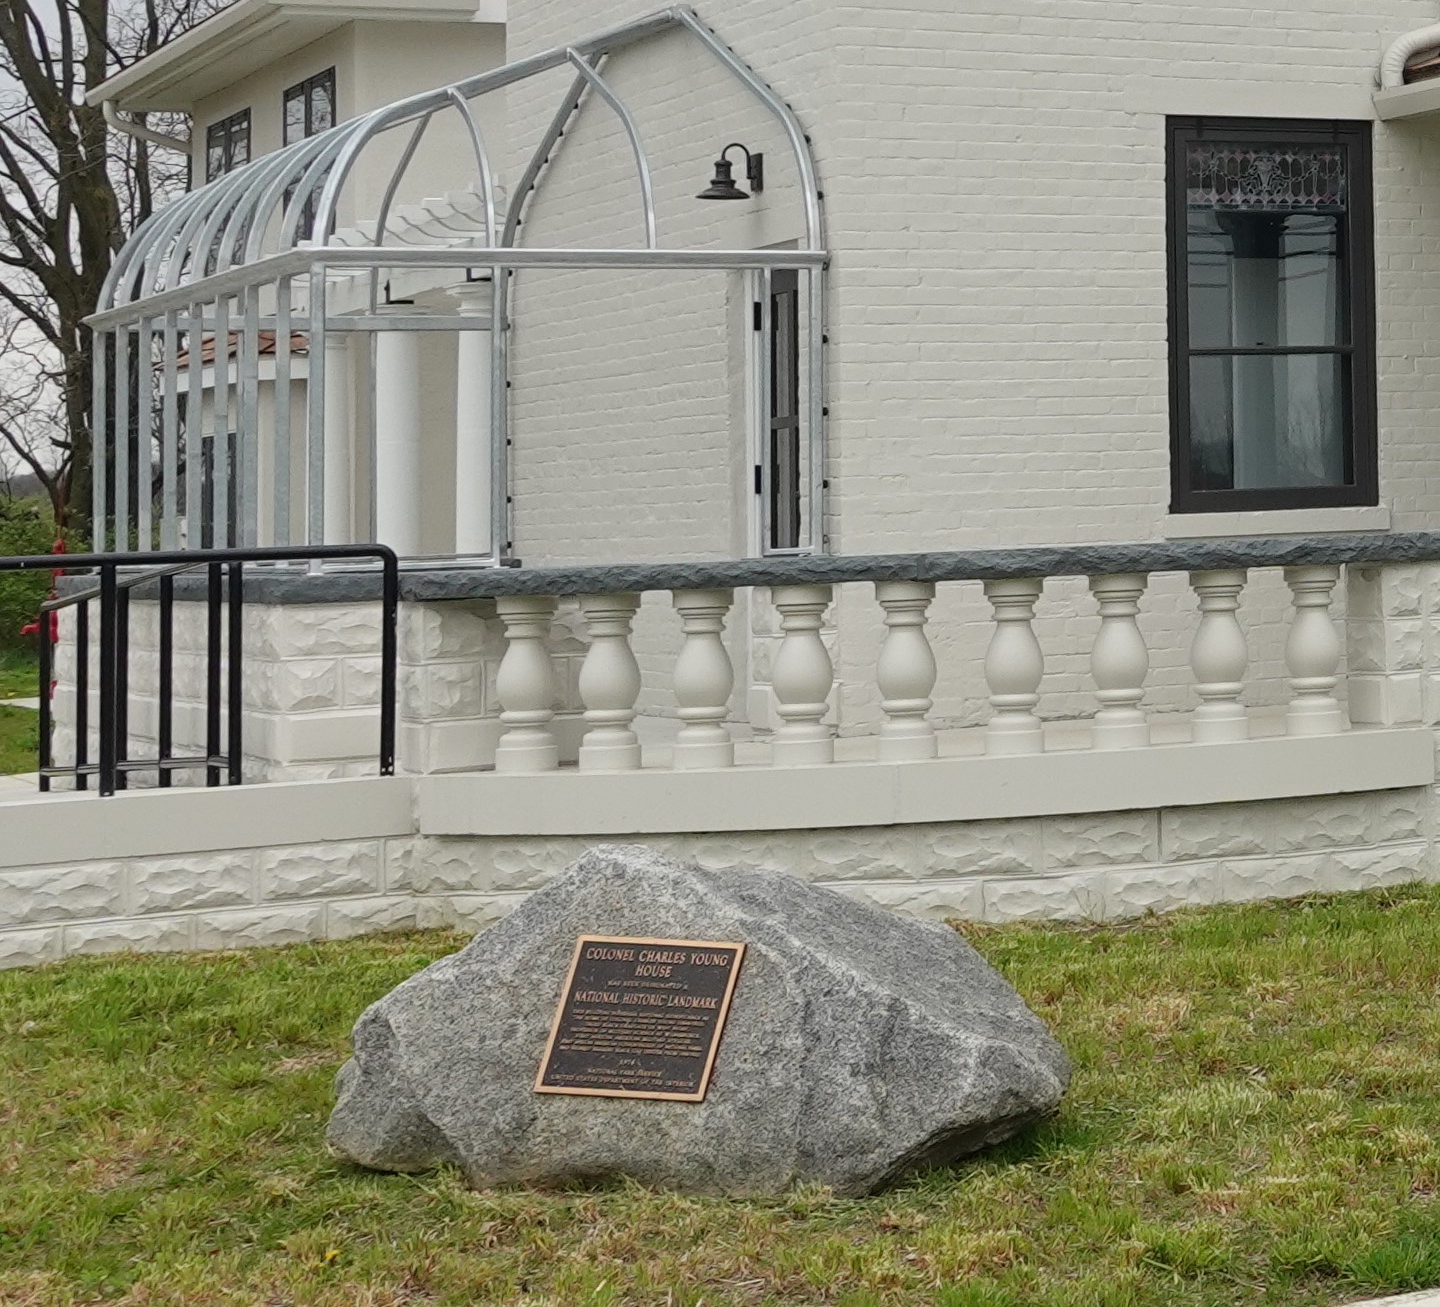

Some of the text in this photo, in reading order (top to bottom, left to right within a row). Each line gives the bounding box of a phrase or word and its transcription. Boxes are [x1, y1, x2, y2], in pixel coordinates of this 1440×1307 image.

[586, 947, 729, 966] COLONEL CHARLES YOUNG
[635, 964, 672, 978] HOUSE
[573, 990, 718, 1009] NATIONAL HISTORIC LANDMARK
